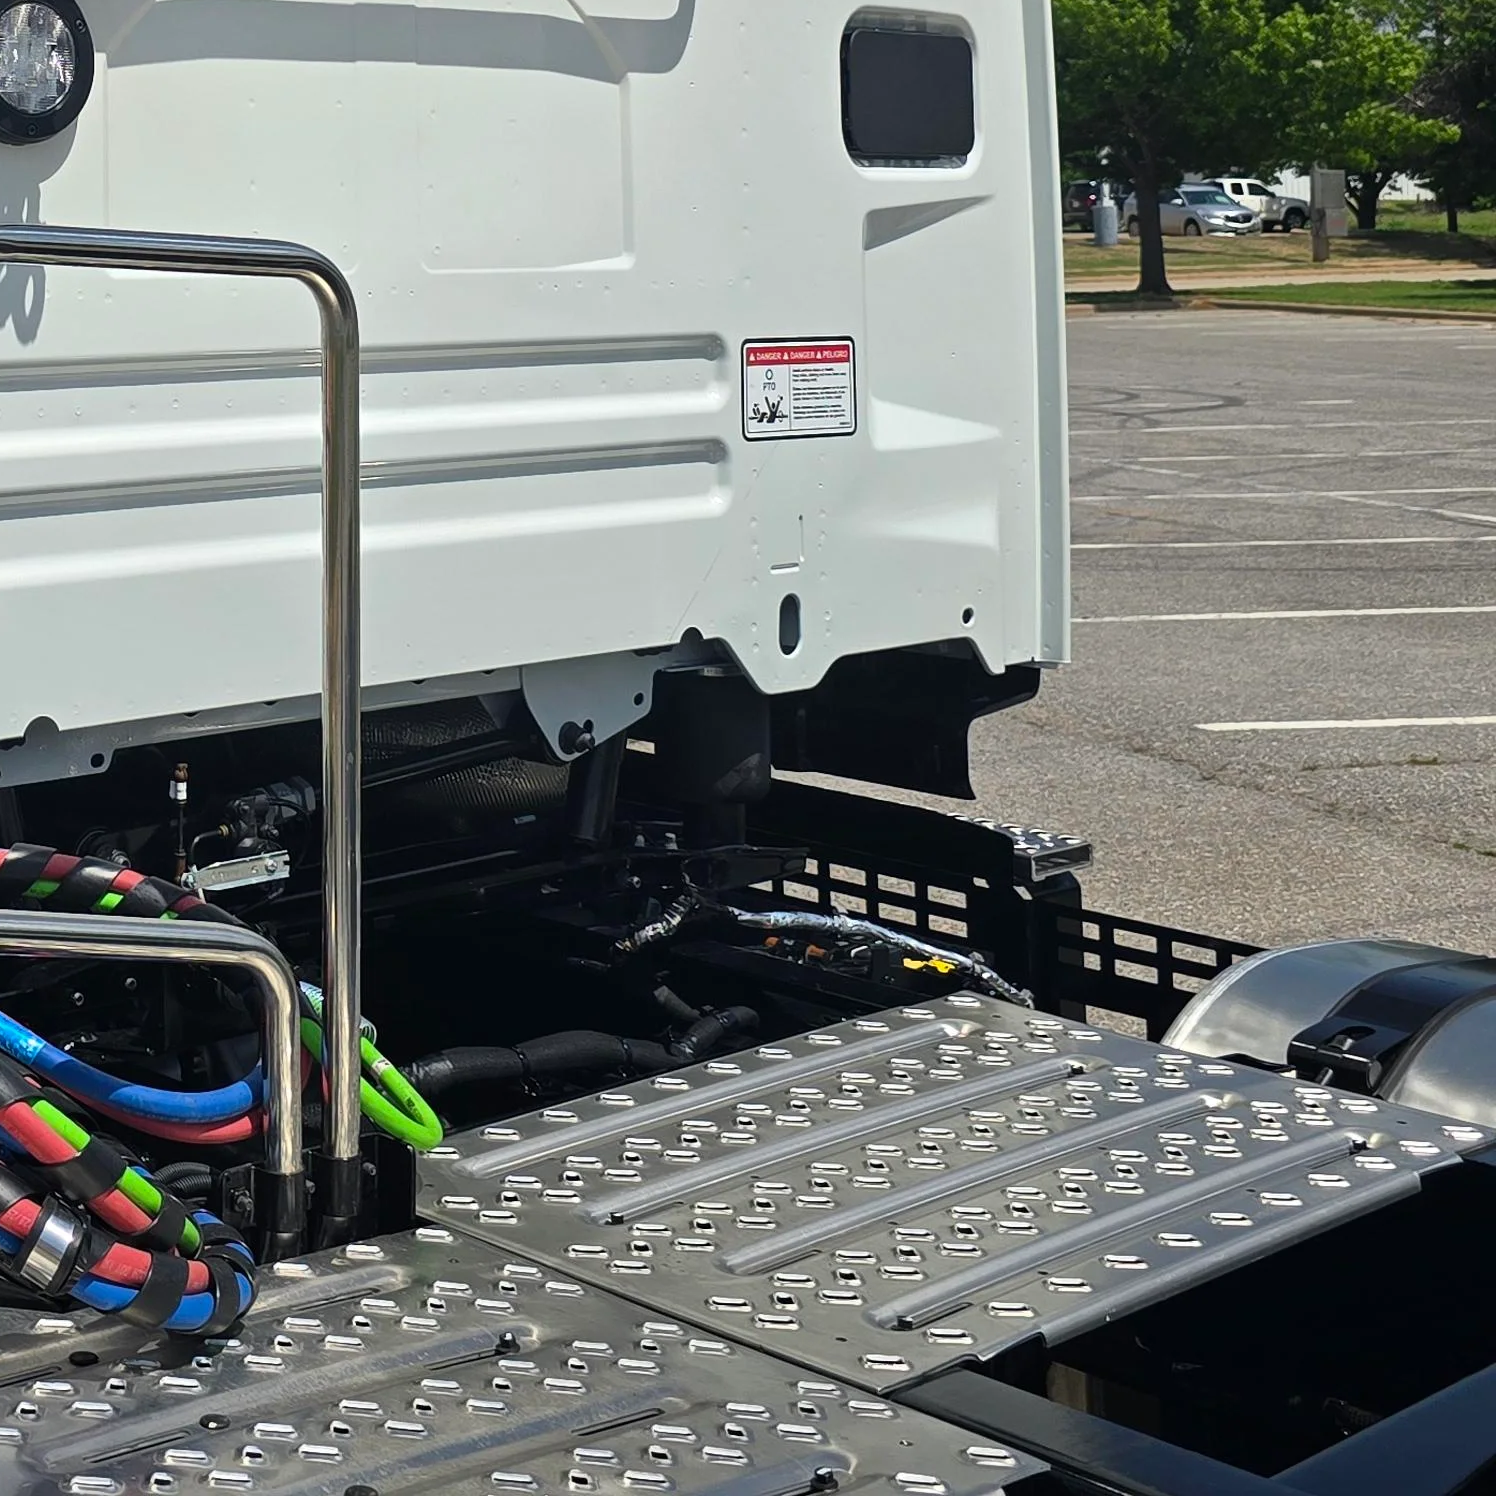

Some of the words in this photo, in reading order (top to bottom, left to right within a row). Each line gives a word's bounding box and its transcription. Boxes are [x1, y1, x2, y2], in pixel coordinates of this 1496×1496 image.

[756, 353, 782, 361] DANGER
[822, 350, 848, 359] PELIGRO
[763, 382, 776, 391] PTO
